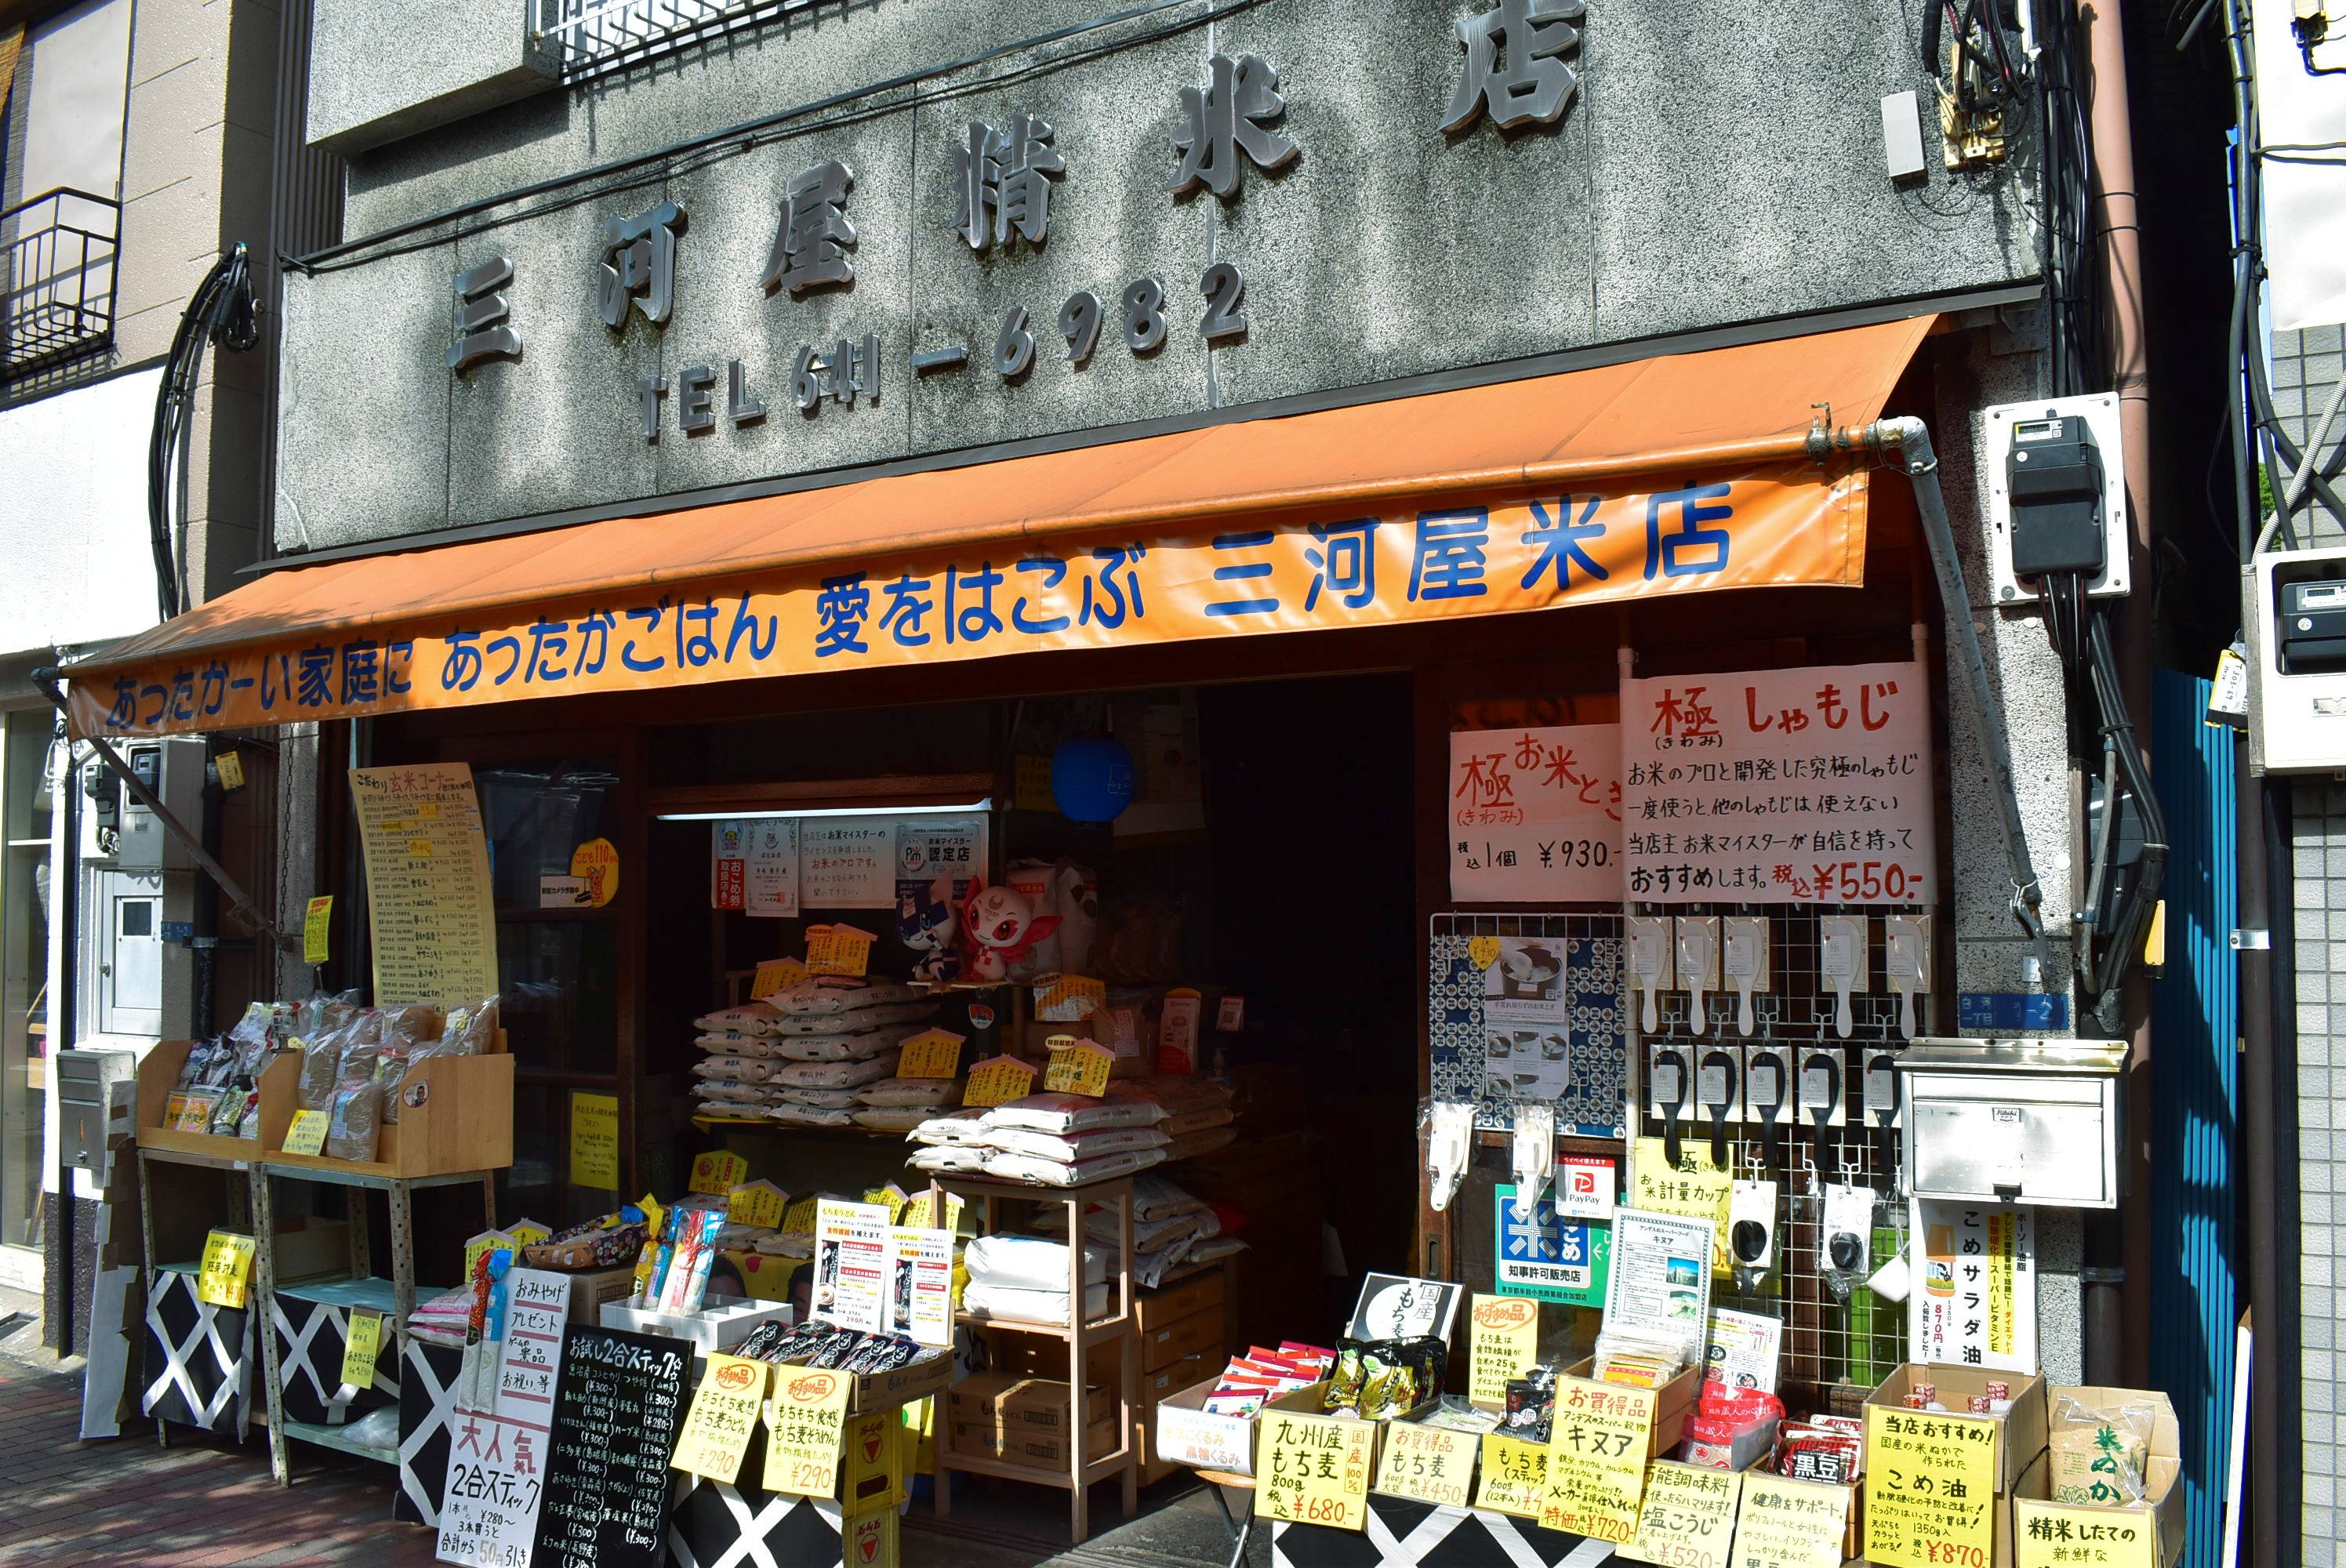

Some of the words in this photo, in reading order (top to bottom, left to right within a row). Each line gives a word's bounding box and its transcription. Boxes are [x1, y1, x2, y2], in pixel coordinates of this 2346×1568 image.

[637, 361, 767, 443] TEL
[107, 636, 413, 729] あったかーい家庭に
[441, 590, 778, 692] あったかごはん
[815, 540, 1151, 658] 愛をはこぶ
[1204, 477, 1733, 619] 三河屋米店
[1651, 686, 1719, 737] 極
[1745, 681, 1899, 734] しゃもじ
[1654, 736, 1723, 749] (きわみ)
[358, 775, 387, 793] こだわり
[390, 771, 454, 792] 玄米コーナー
[1455, 754, 1514, 807] 極
[1457, 808, 1523, 826] (きわみ)
[929, 848, 970, 861] 認定店
[730, 862, 742, 906] おこめ券
[1630, 864, 1767, 894] おすすめします。
[1570, 1194, 1600, 1204] PayPay
[1659, 1181, 1729, 1202] 計量カップ
[1653, 1236, 1673, 1245] キヌア
[1509, 1265, 1581, 1282] 知事許可販売店
[515, 1278, 566, 1304] おみやげ
[1963, 1210, 1981, 1364] こめサラダ油
[1392, 1287, 1414, 1338] もち麦
[1414, 1286, 1443, 1320] 国産
[1474, 1301, 1525, 1323] おすすめ品
[510, 1312, 558, 1332] プレゼント
[1934, 1305, 1943, 1343] 870円
[1480, 1334, 1513, 1344] もち麦は
[716, 1365, 749, 1385] おすすめ品
[788, 1377, 826, 1396] おすすめ品
[703, 1391, 756, 1415] もちもち食感
[1568, 1386, 1647, 1418] お買得品
[695, 1406, 747, 1435] もち麦うどん
[779, 1403, 838, 1428] もちもち食感
[775, 1424, 839, 1446] もち麦そうめん
[1276, 1420, 1343, 1450] 九州産
[1396, 1428, 1454, 1453] お買得品
[1568, 1425, 1633, 1457] キヌア
[1886, 1415, 1994, 1446] 当店おすすめ!
[457, 1417, 536, 1475] 大人気
[1881, 1436, 1964, 1457] 国産の米ぬかで
[1273, 1447, 1338, 1479] もち麦
[1393, 1450, 1445, 1478] もち麦
[1794, 1454, 1839, 1481] 黒豆
[1923, 1456, 1966, 1471] 作られた
[451, 1464, 540, 1515] 2合スティック
[1272, 1474, 1305, 1492] 800g
[1490, 1478, 1513, 1492] 600g
[1887, 1468, 1967, 1498] こめ油
[1545, 1506, 1578, 1530] 特価
[1642, 1506, 1719, 1536] 塩こうじ
[2028, 1516, 2136, 1542] 精米したての
[2053, 1546, 2108, 1563] 新鮮な
